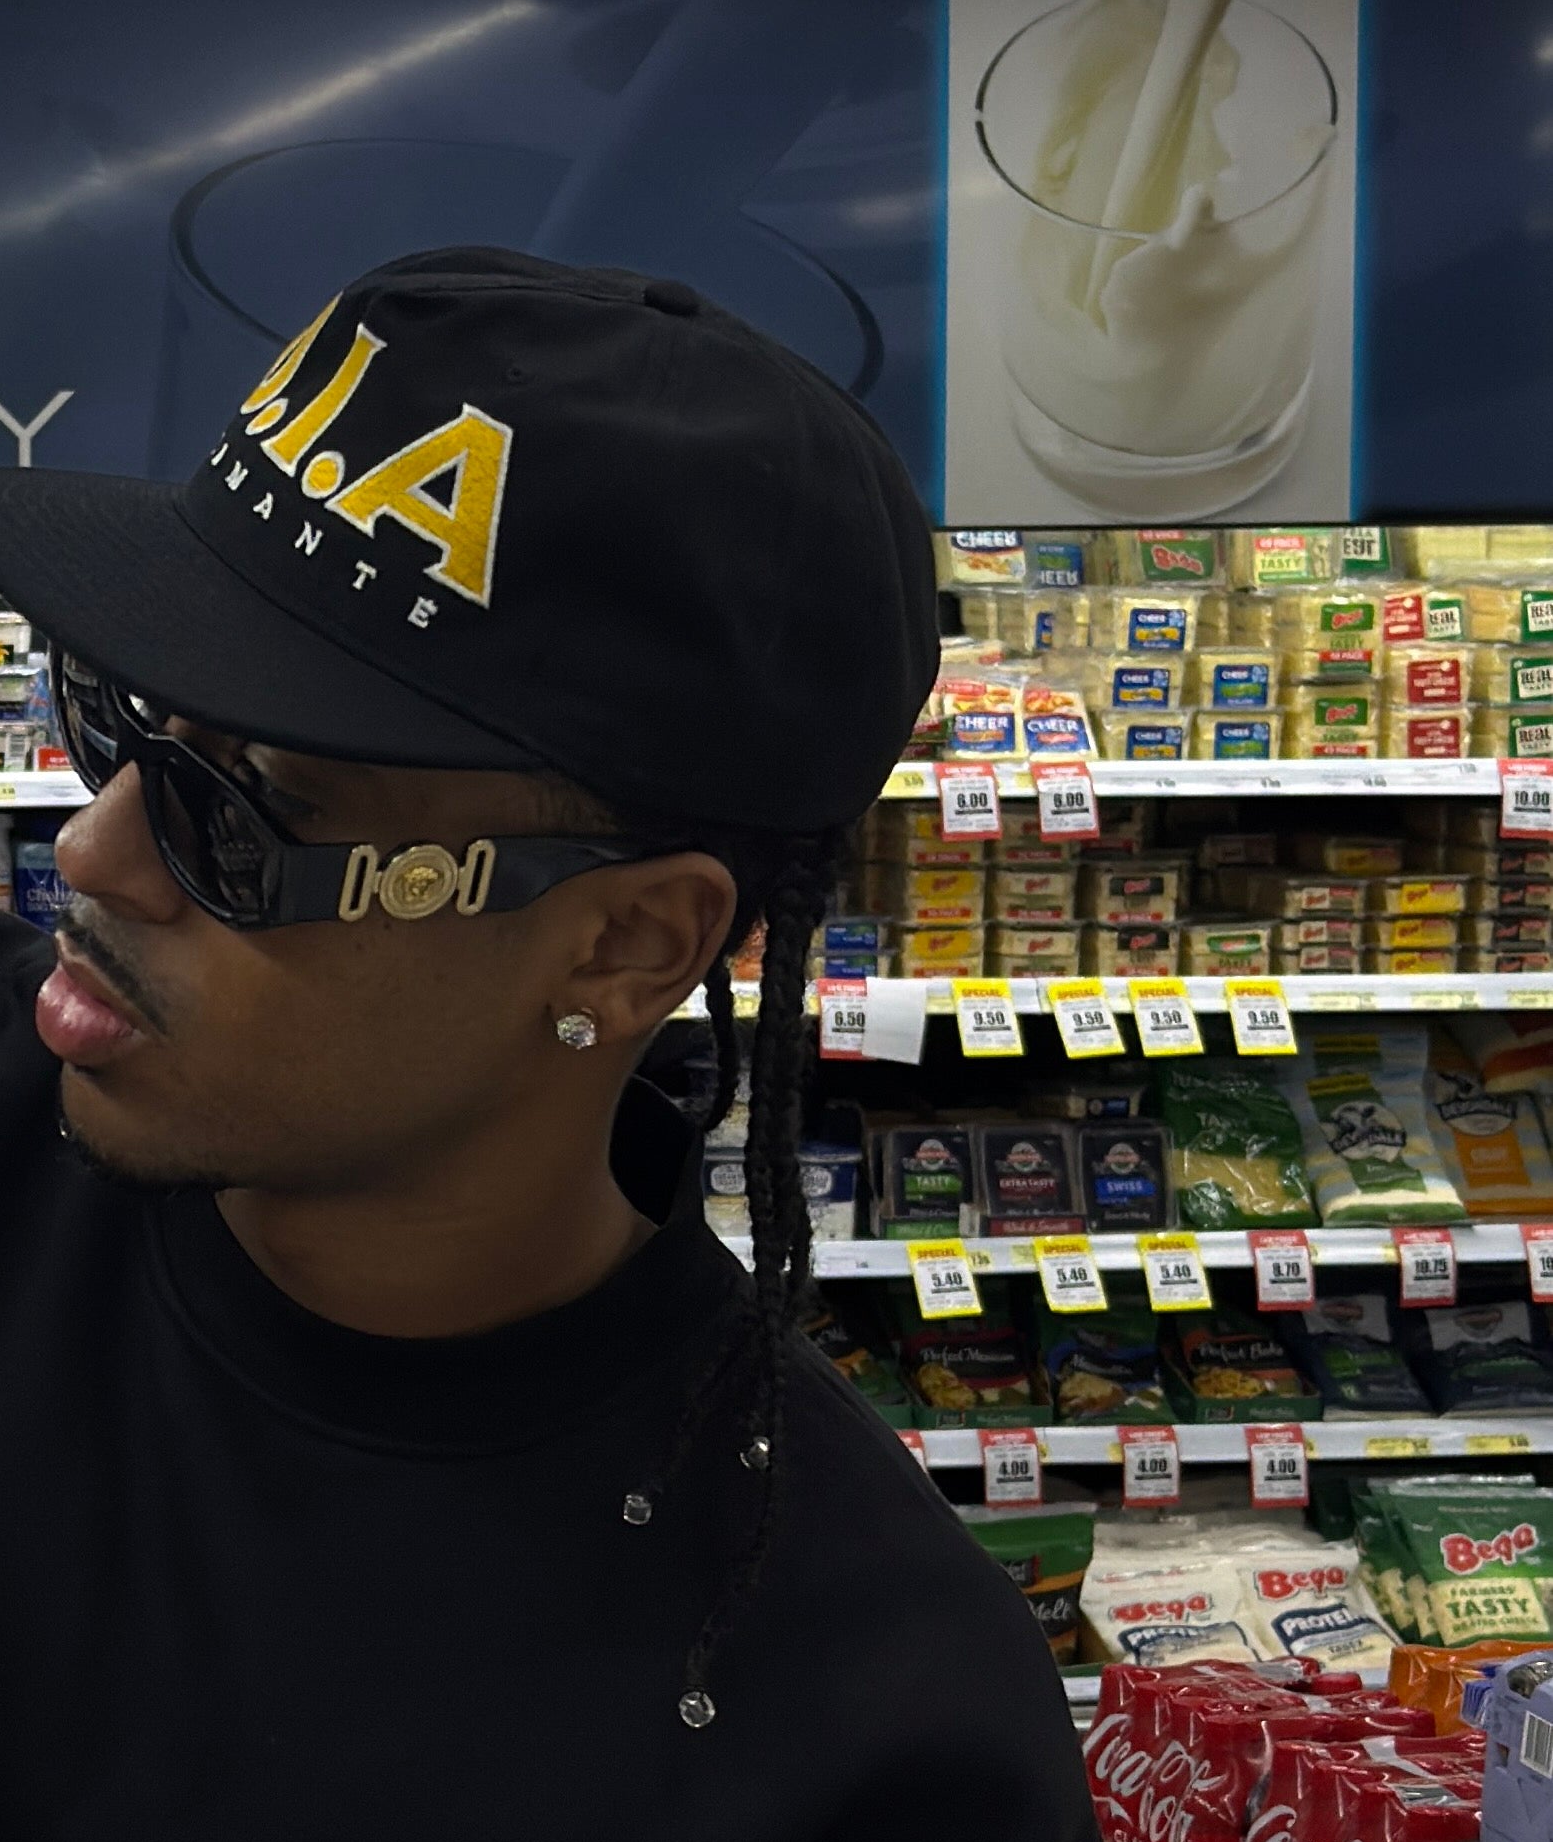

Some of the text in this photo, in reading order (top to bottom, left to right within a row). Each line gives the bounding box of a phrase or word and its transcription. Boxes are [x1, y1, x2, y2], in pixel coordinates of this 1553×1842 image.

[954, 715, 1009, 732] CHEER
[1027, 719, 1080, 735] CHEER
[956, 792, 988, 808] 6.00
[1514, 790, 1551, 807] 10.00
[962, 987, 1003, 998] SPECIAL
[1057, 987, 1096, 1000] SPECIAL
[1138, 987, 1178, 998] SPECIAL
[1234, 987, 1273, 997] SPECIAL
[834, 1011, 865, 1028] 6.50
[973, 1010, 1005, 1026] 9.50
[1072, 1010, 1104, 1027] 9.50
[1150, 1010, 1182, 1027] 9.50
[1247, 1010, 1280, 1026] 9.50
[916, 1175, 949, 1187] TASTY
[1107, 1180, 1144, 1193] SWISS
[917, 1247, 957, 1259] SPECIAL
[931, 1271, 963, 1288] 5.40
[1056, 1266, 1088, 1283] 5.40
[1160, 1264, 1192, 1280] 5.40
[998, 1460, 1029, 1476] 4.00
[1137, 1458, 1168, 1474] 4.00
[1266, 1458, 1297, 1475] 4.00
[1439, 1522, 1539, 1576] Bega
[1253, 1565, 1348, 1603] Bega
[1446, 1597, 1529, 1619] TASTY
